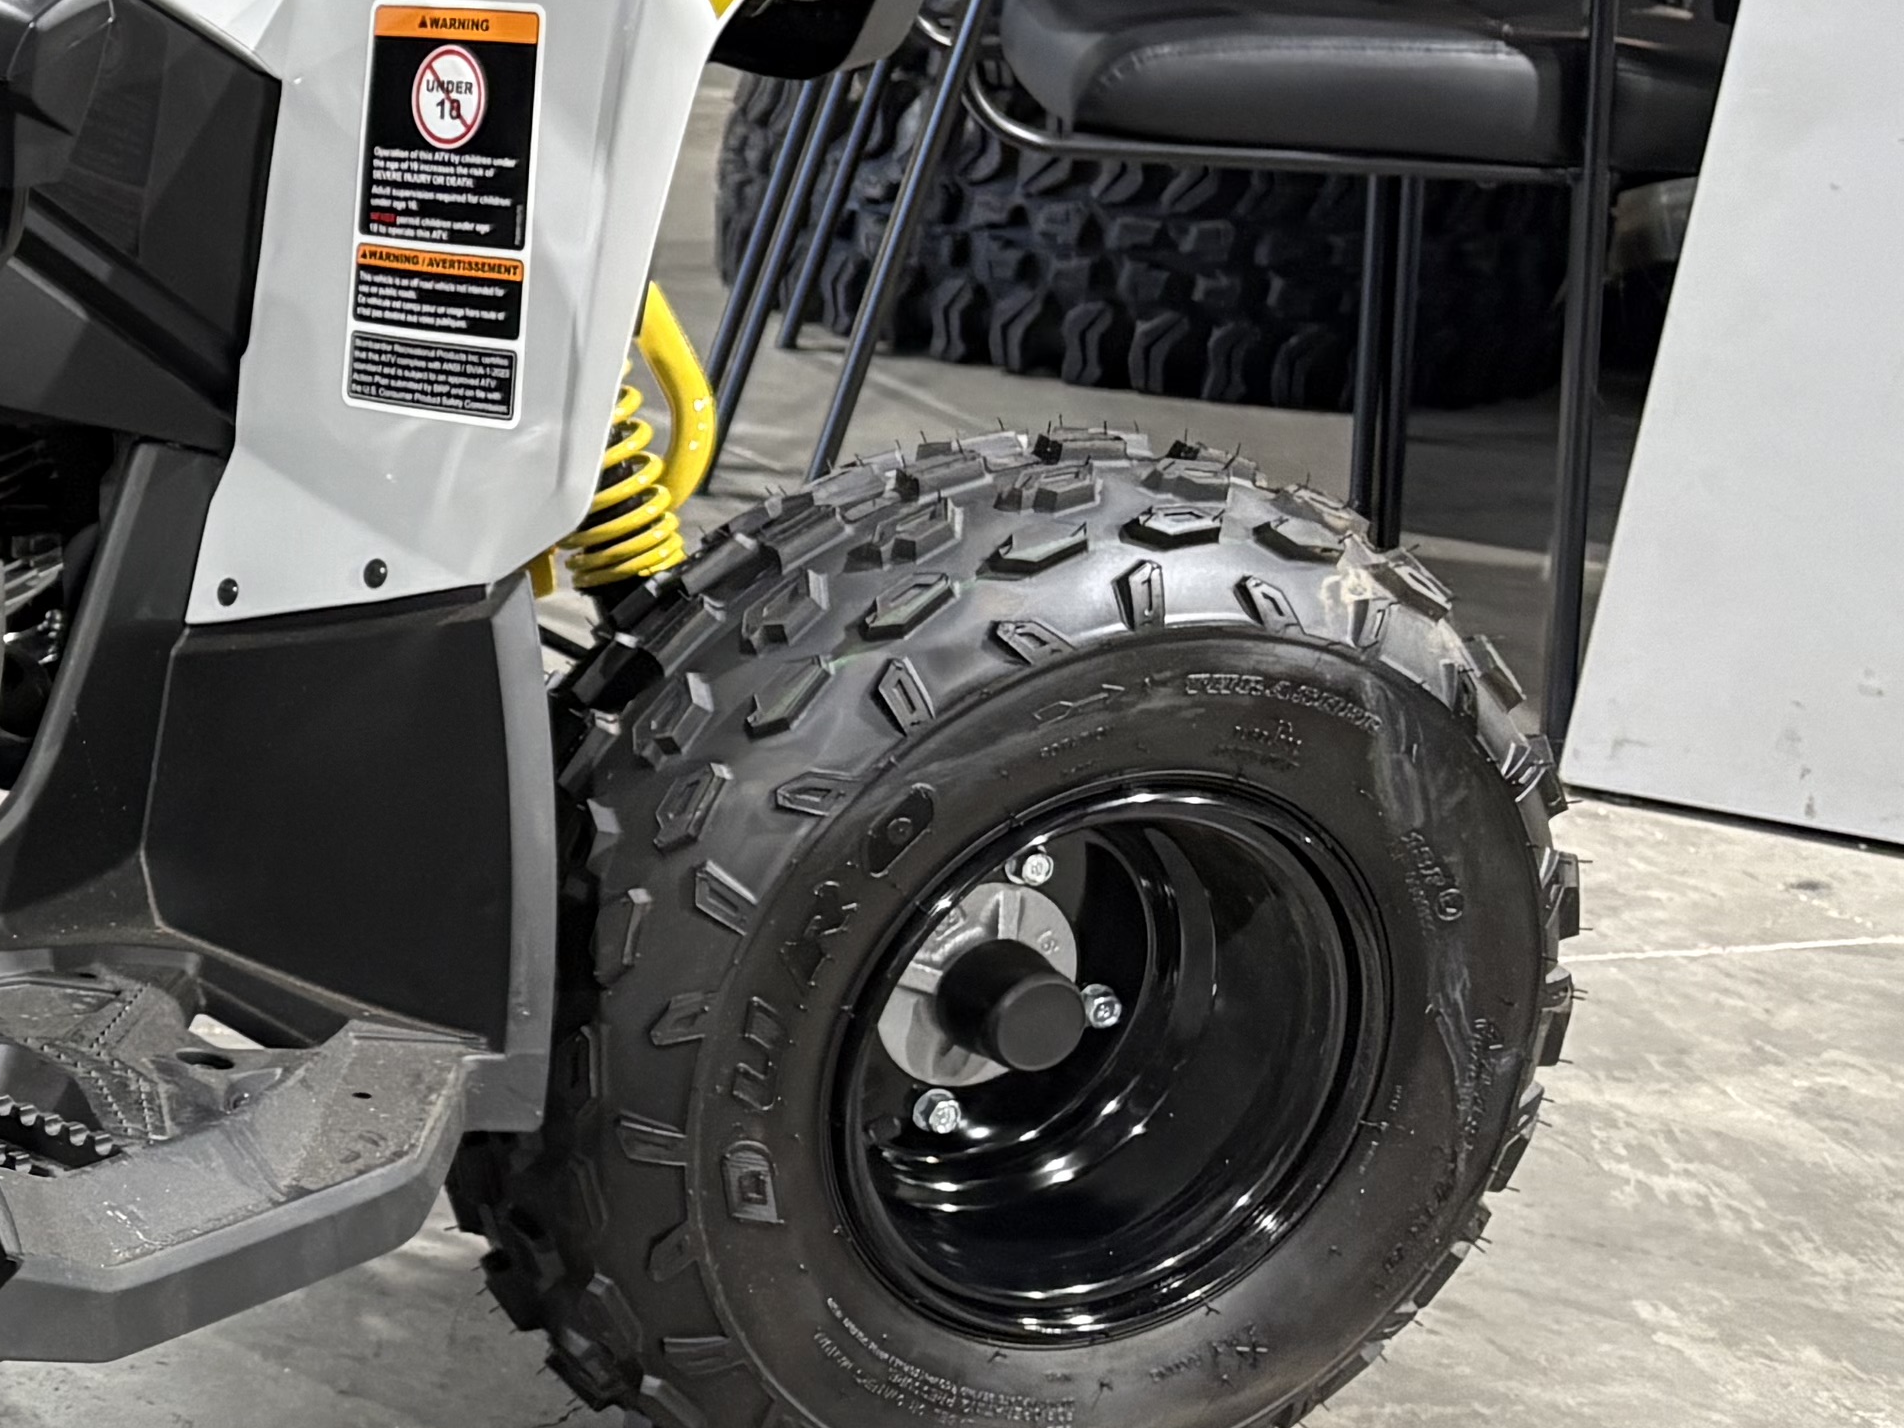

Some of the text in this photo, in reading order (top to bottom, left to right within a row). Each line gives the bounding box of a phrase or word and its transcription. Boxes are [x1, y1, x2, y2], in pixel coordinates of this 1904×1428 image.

[430, 18, 490, 32] WARNING
[426, 78, 473, 95] UNDER
[373, 169, 402, 182] SEVERE
[403, 172, 431, 184] INJURY
[432, 175, 445, 185] OR
[392, 187, 435, 199] supervision
[479, 195, 512, 207] children
[368, 249, 420, 266] WARNING
[426, 257, 520, 276] AVERTISSEMENT
[721, 782, 936, 1225] DURO
